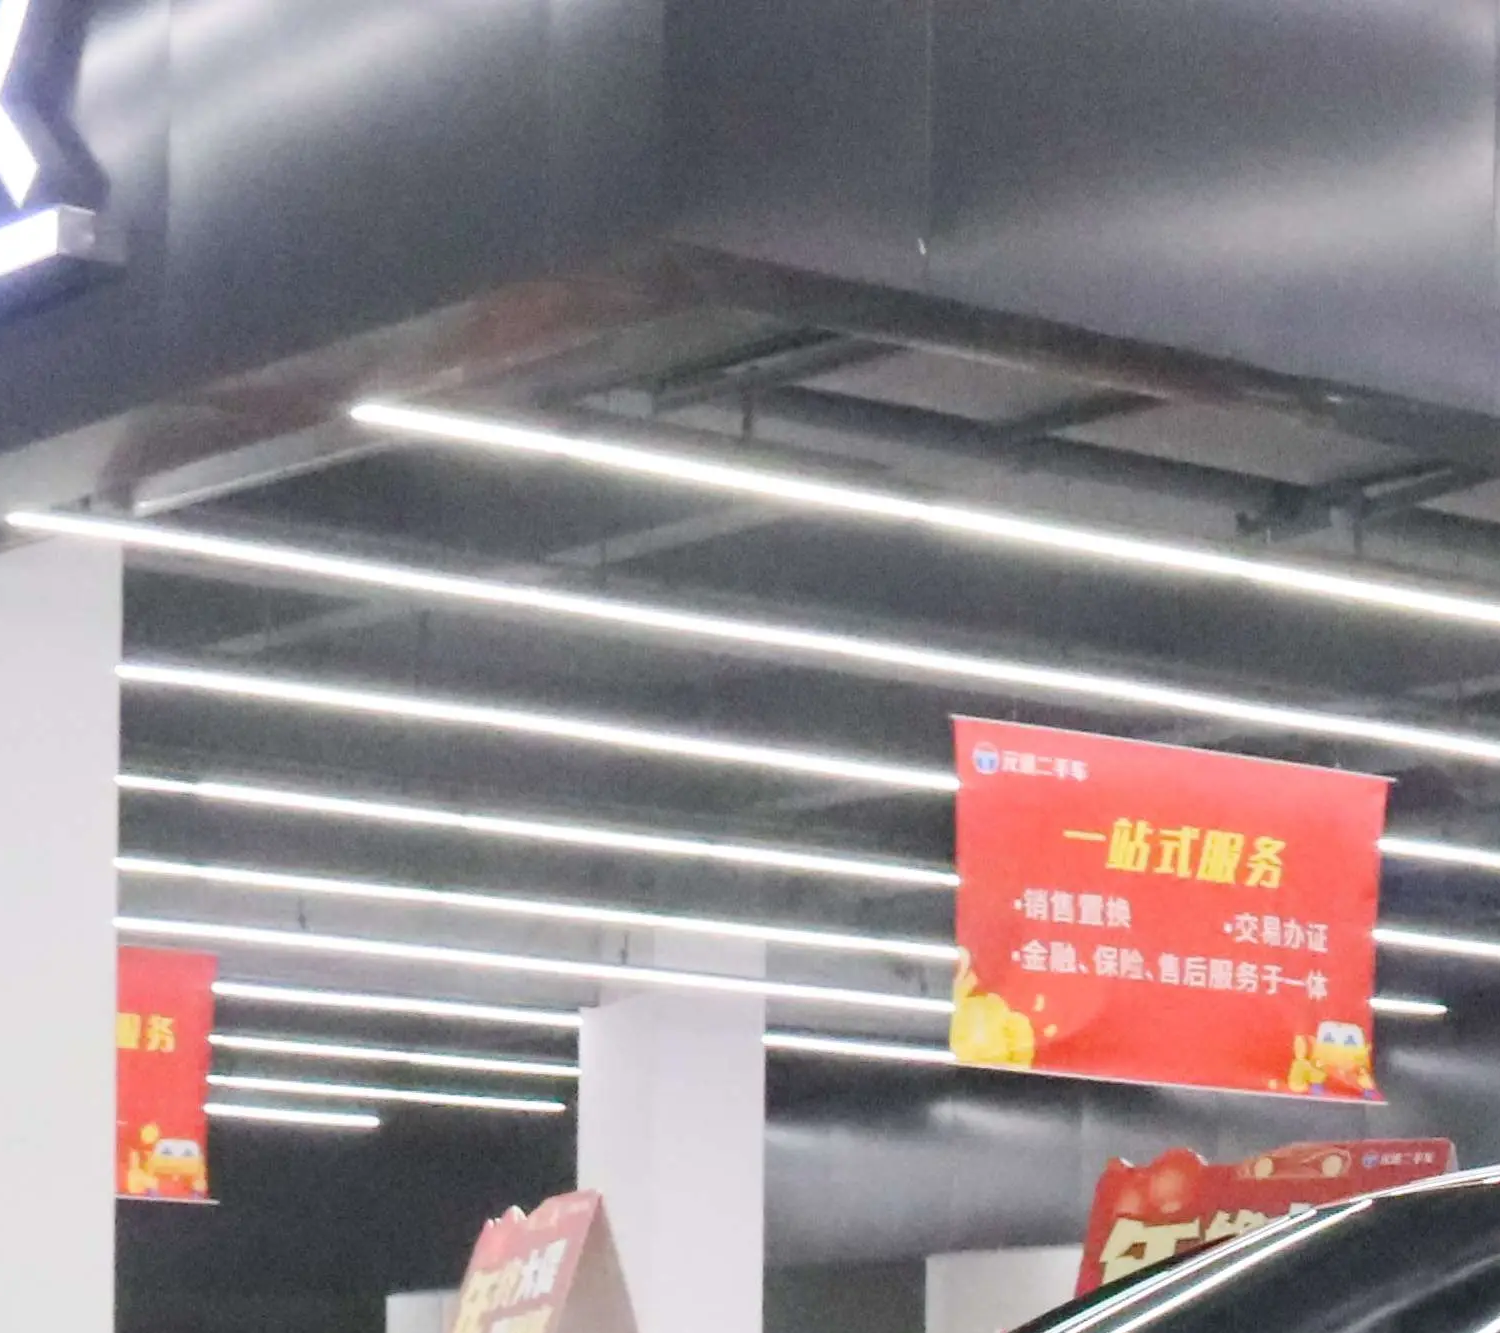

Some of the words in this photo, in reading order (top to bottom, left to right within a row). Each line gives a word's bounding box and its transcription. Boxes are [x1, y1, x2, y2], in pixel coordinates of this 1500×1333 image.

[1062, 817, 1289, 890] 一站式服务
